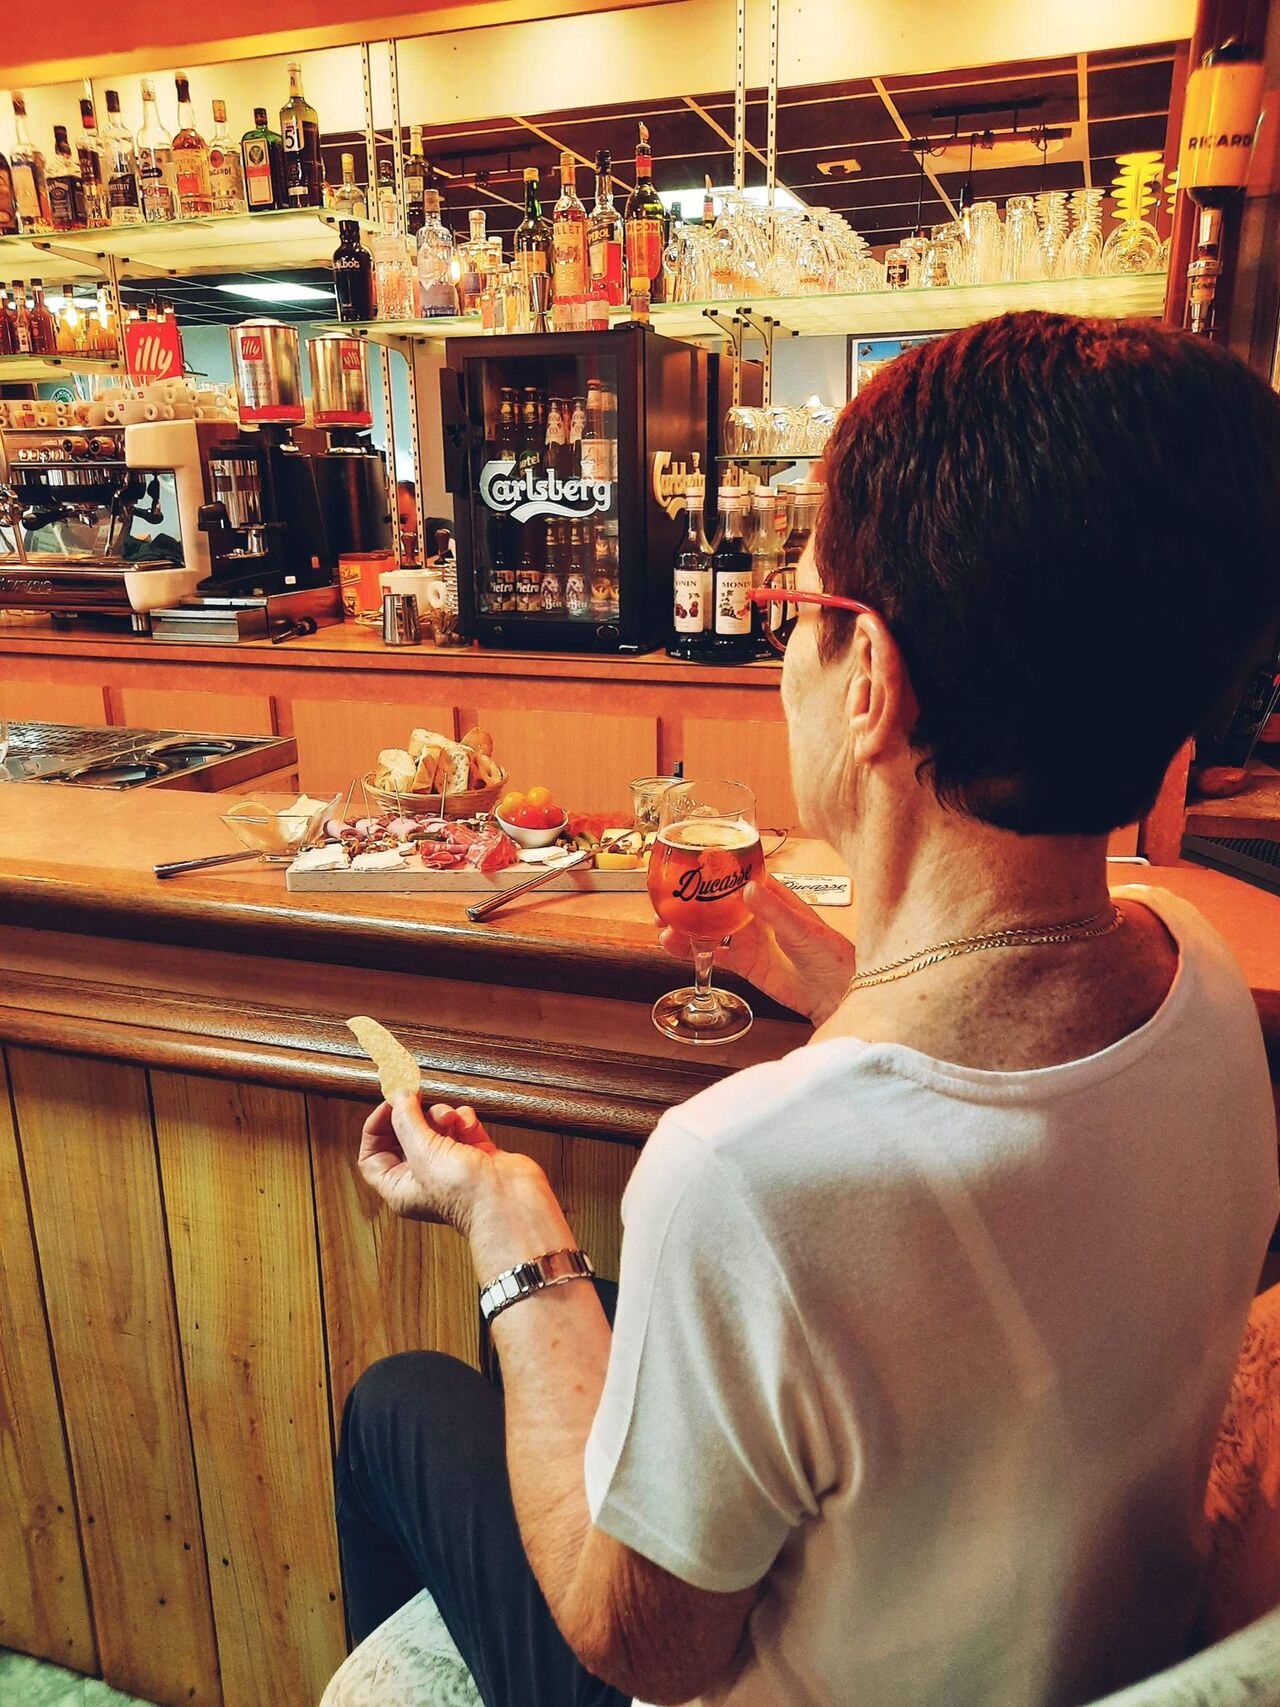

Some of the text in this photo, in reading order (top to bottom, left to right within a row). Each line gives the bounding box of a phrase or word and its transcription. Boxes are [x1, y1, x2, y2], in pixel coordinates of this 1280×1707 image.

[1188, 134, 1254, 151] RICARD
[135, 336, 173, 380] illy
[243, 341, 260, 356] illy
[480, 460, 612, 512] Carlsberg
[672, 865, 752, 902] Ducasse
